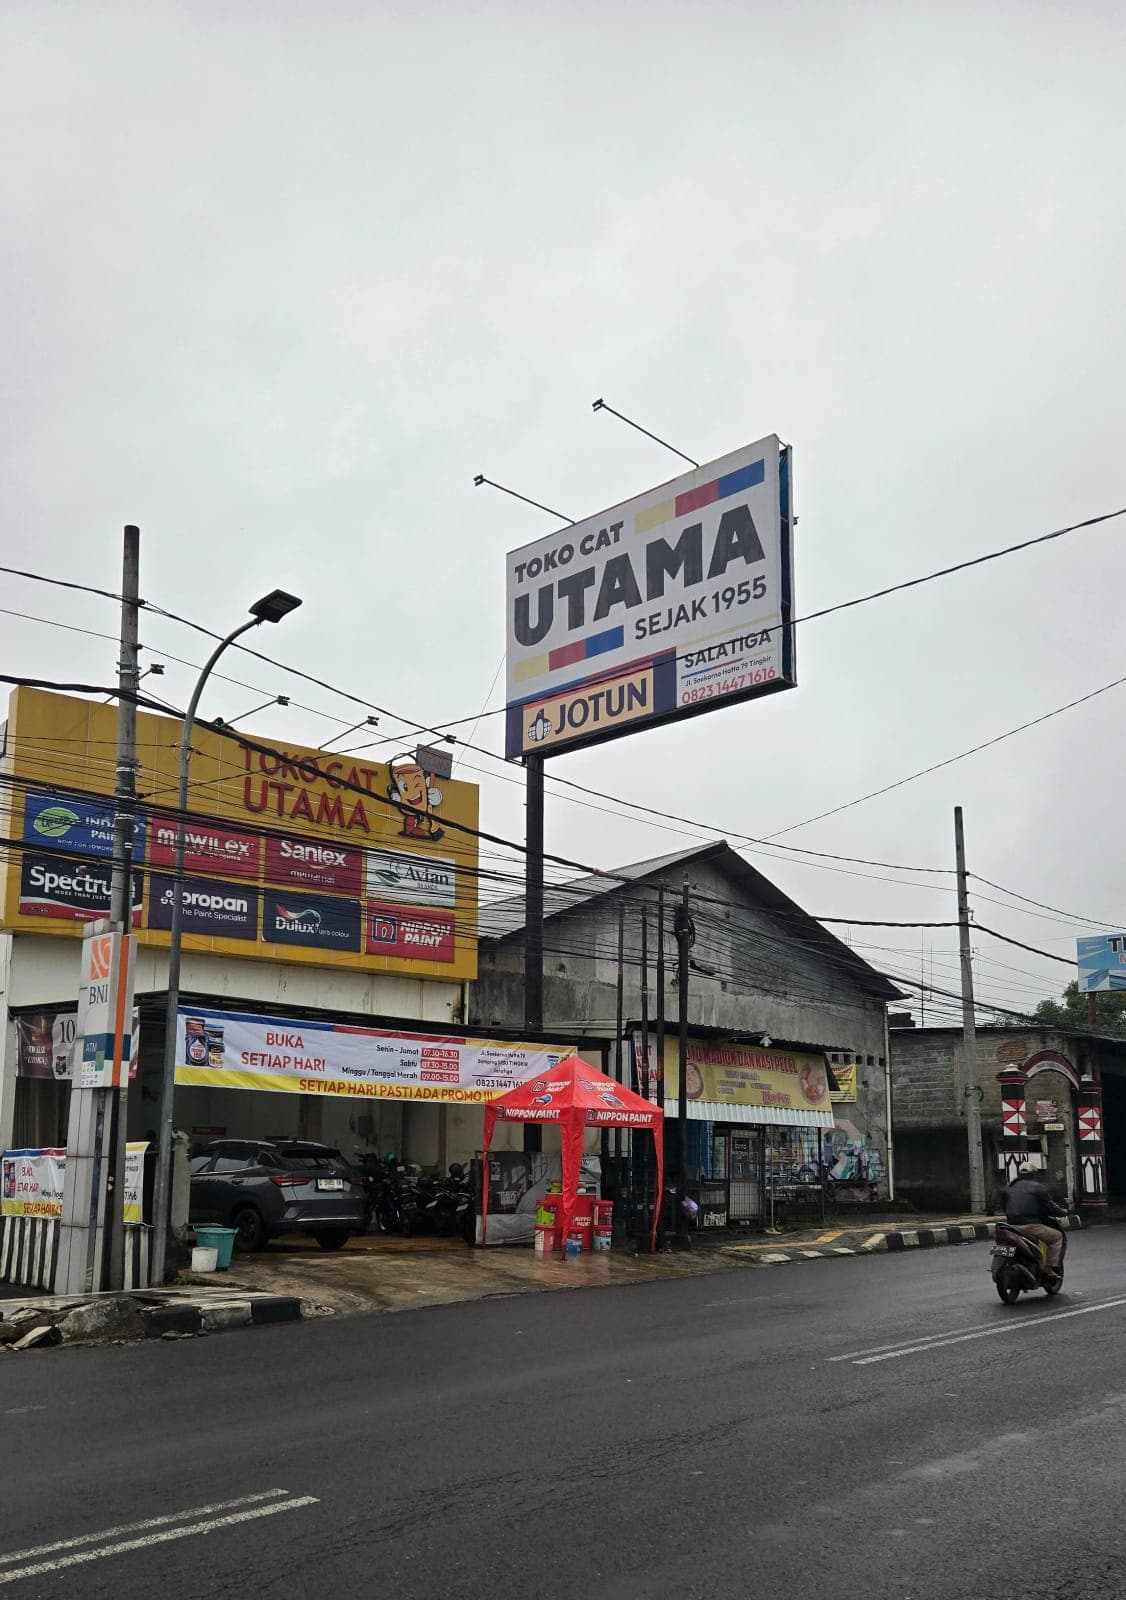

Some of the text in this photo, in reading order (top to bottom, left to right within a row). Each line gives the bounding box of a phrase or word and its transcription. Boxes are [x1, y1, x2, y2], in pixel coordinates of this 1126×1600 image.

[514, 521, 625, 583] TOKO CAT
[514, 503, 766, 647] UTAMA
[635, 575, 767, 640] SEJAK 1955
[684, 629, 772, 669] SALATIGA
[694, 672, 722, 685] Soekarno
[722, 665, 740, 676] Hatta
[750, 656, 772, 667] Tingkir
[681, 666, 776, 705] 0823 1447 1616
[555, 677, 648, 735] JOTUN
[239, 744, 378, 791] TOKO CAT
[243, 777, 371, 833] UTAMA
[280, 840, 347, 867] Sanlex
[405, 866, 449, 885] Avian
[194, 909, 212, 918] Paint
[214, 911, 247, 923] Specialist
[275, 916, 315, 934] Dulux
[400, 921, 451, 936] NIPPON
[404, 933, 442, 947] PAINT
[88, 984, 109, 1005] BNI
[60, 1019, 76, 1044] 10
[266, 1032, 304, 1049] BUKA
[376, 1044, 394, 1053] Senin
[400, 1047, 419, 1056] Jumat
[241, 1051, 326, 1072] SETIAP HARI
[400, 1060, 418, 1068] Sabtu
[341, 1067, 366, 1077] Minggu
[371, 1069, 397, 1079] Tanggal
[398, 1071, 418, 1079] Merah
[476, 1079, 495, 1088] 0823
[496, 1080, 512, 1088] 1447
[299, 1078, 493, 1102] SETIAP HARI PASTI ADA PROMO !!!
[505, 1108, 560, 1118] NIPPON PAINT
[597, 1111, 653, 1123] NIPPON PAINT
